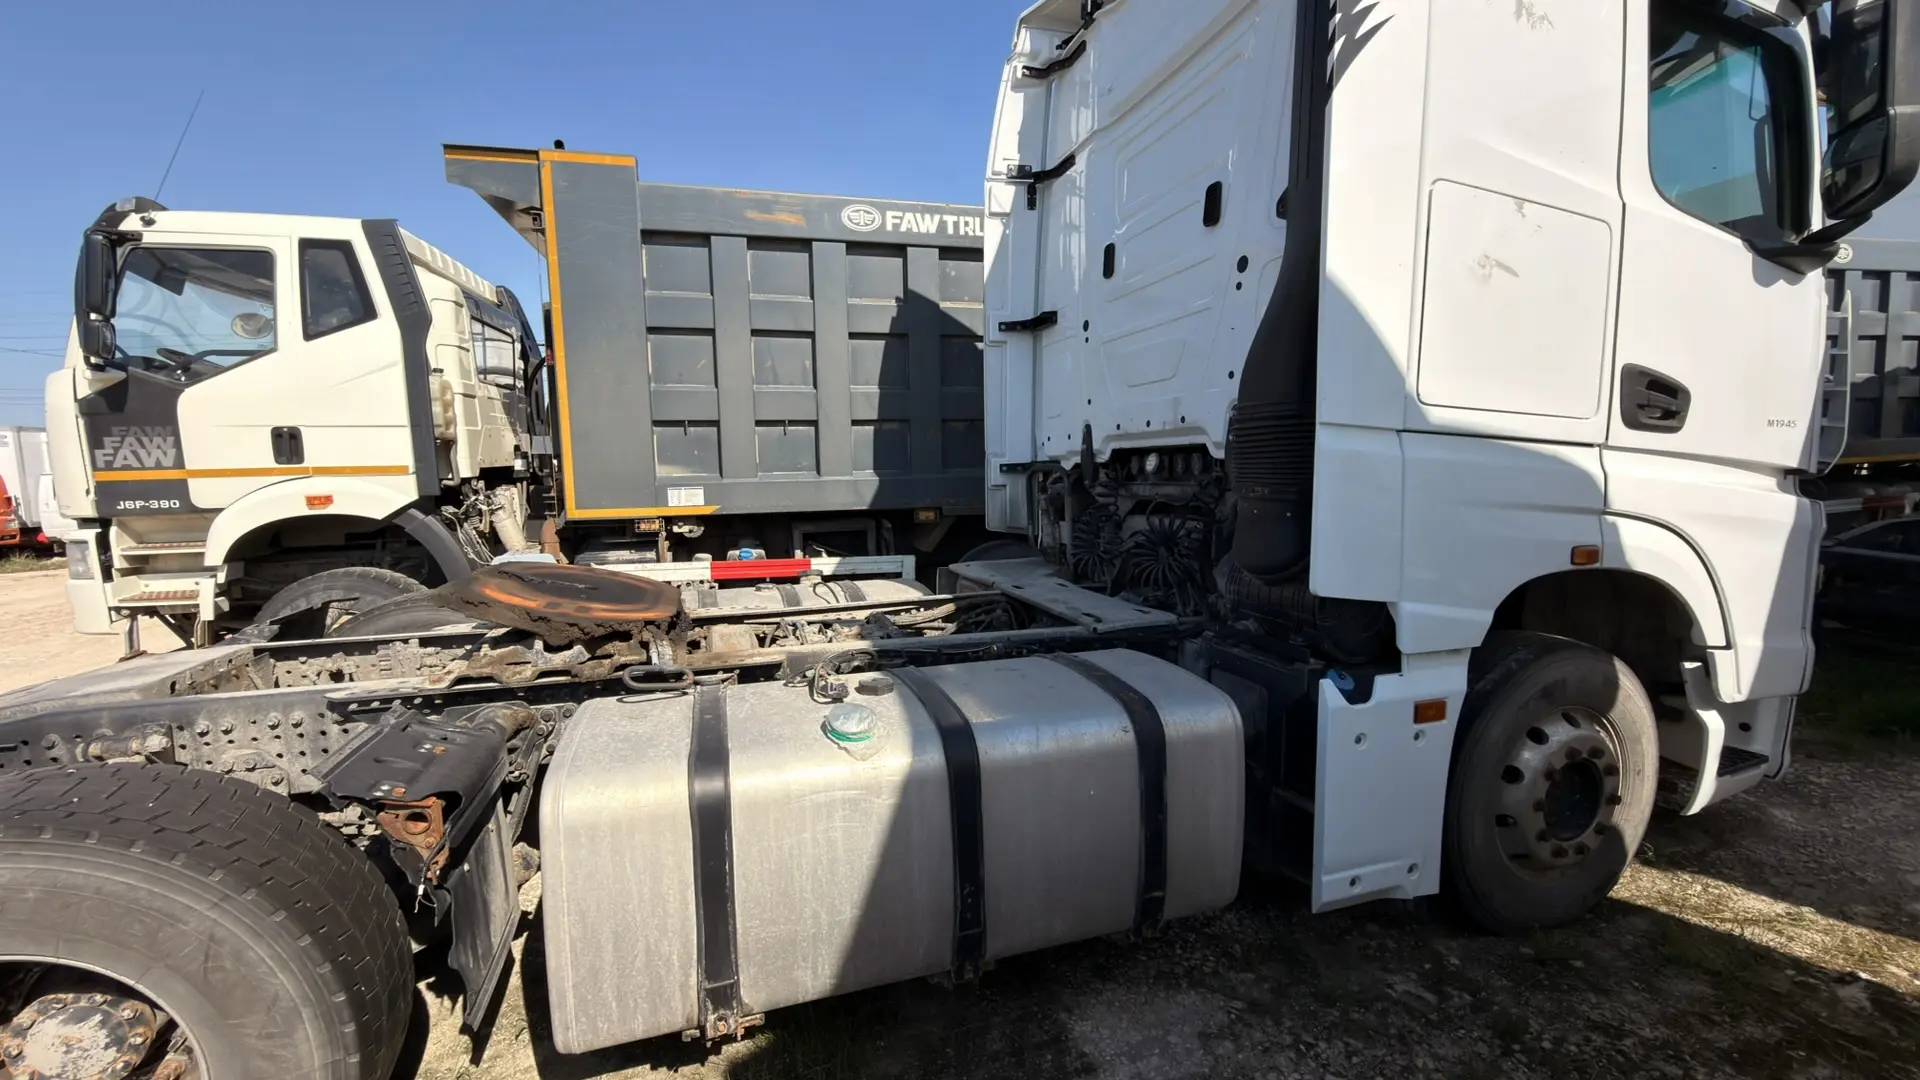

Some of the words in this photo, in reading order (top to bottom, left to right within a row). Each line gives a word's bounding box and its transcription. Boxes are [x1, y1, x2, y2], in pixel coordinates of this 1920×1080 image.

[886, 210, 941, 234] FAW
[103, 436, 175, 450] FAW
[94, 449, 176, 468] FAW
[116, 500, 180, 509] J6P-390
